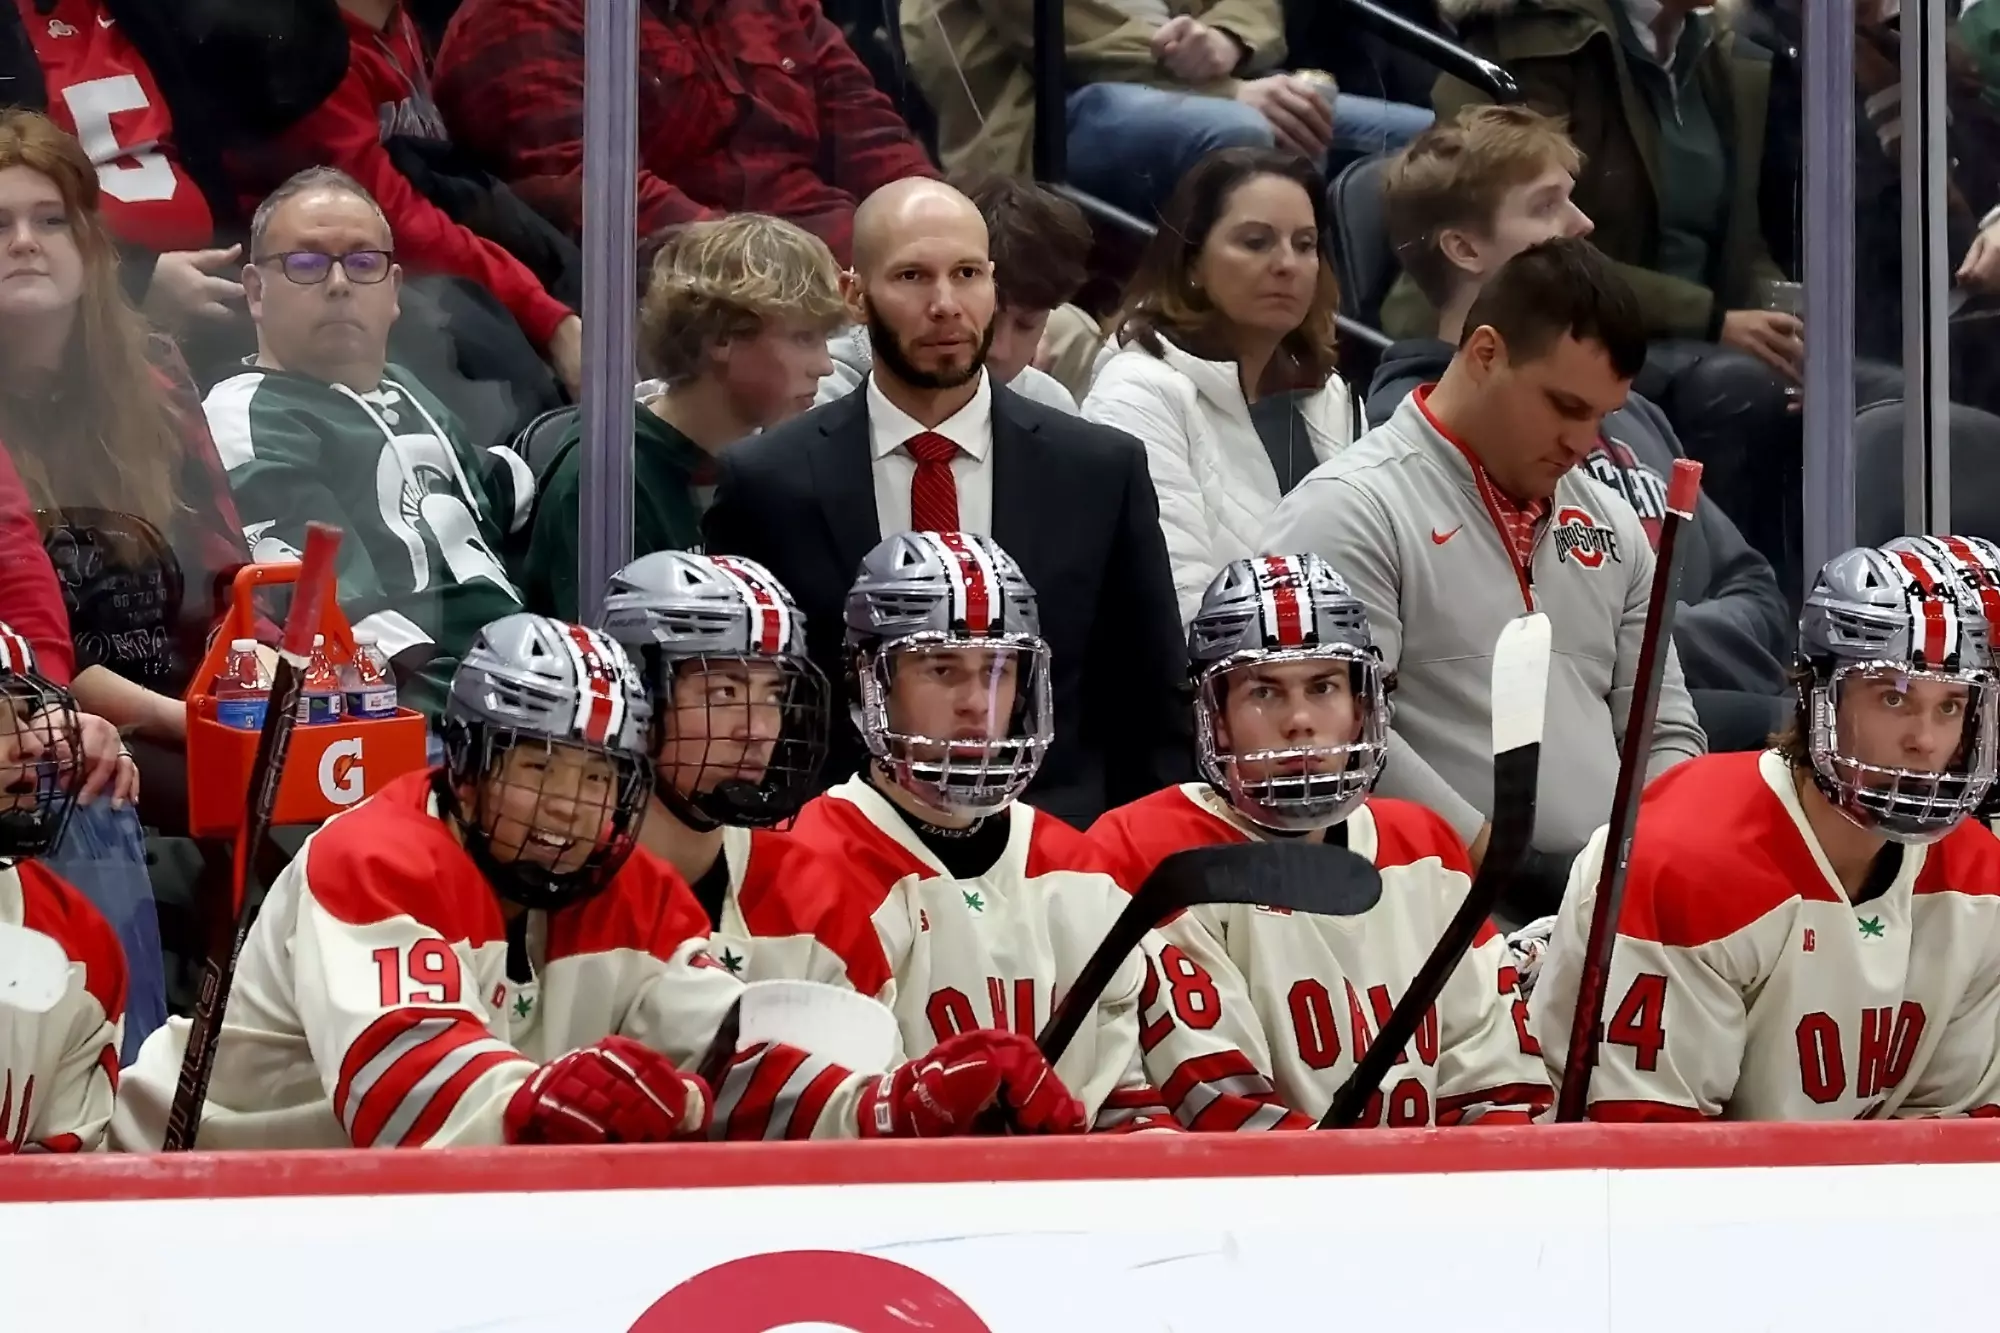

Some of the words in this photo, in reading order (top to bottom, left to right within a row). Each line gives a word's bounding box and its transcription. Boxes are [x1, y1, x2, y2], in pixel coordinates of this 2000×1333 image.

[318, 737, 365, 806] G
[373, 937, 461, 1007] 19
[1138, 944, 1222, 1056] 28
[1592, 973, 1668, 1072] 4
